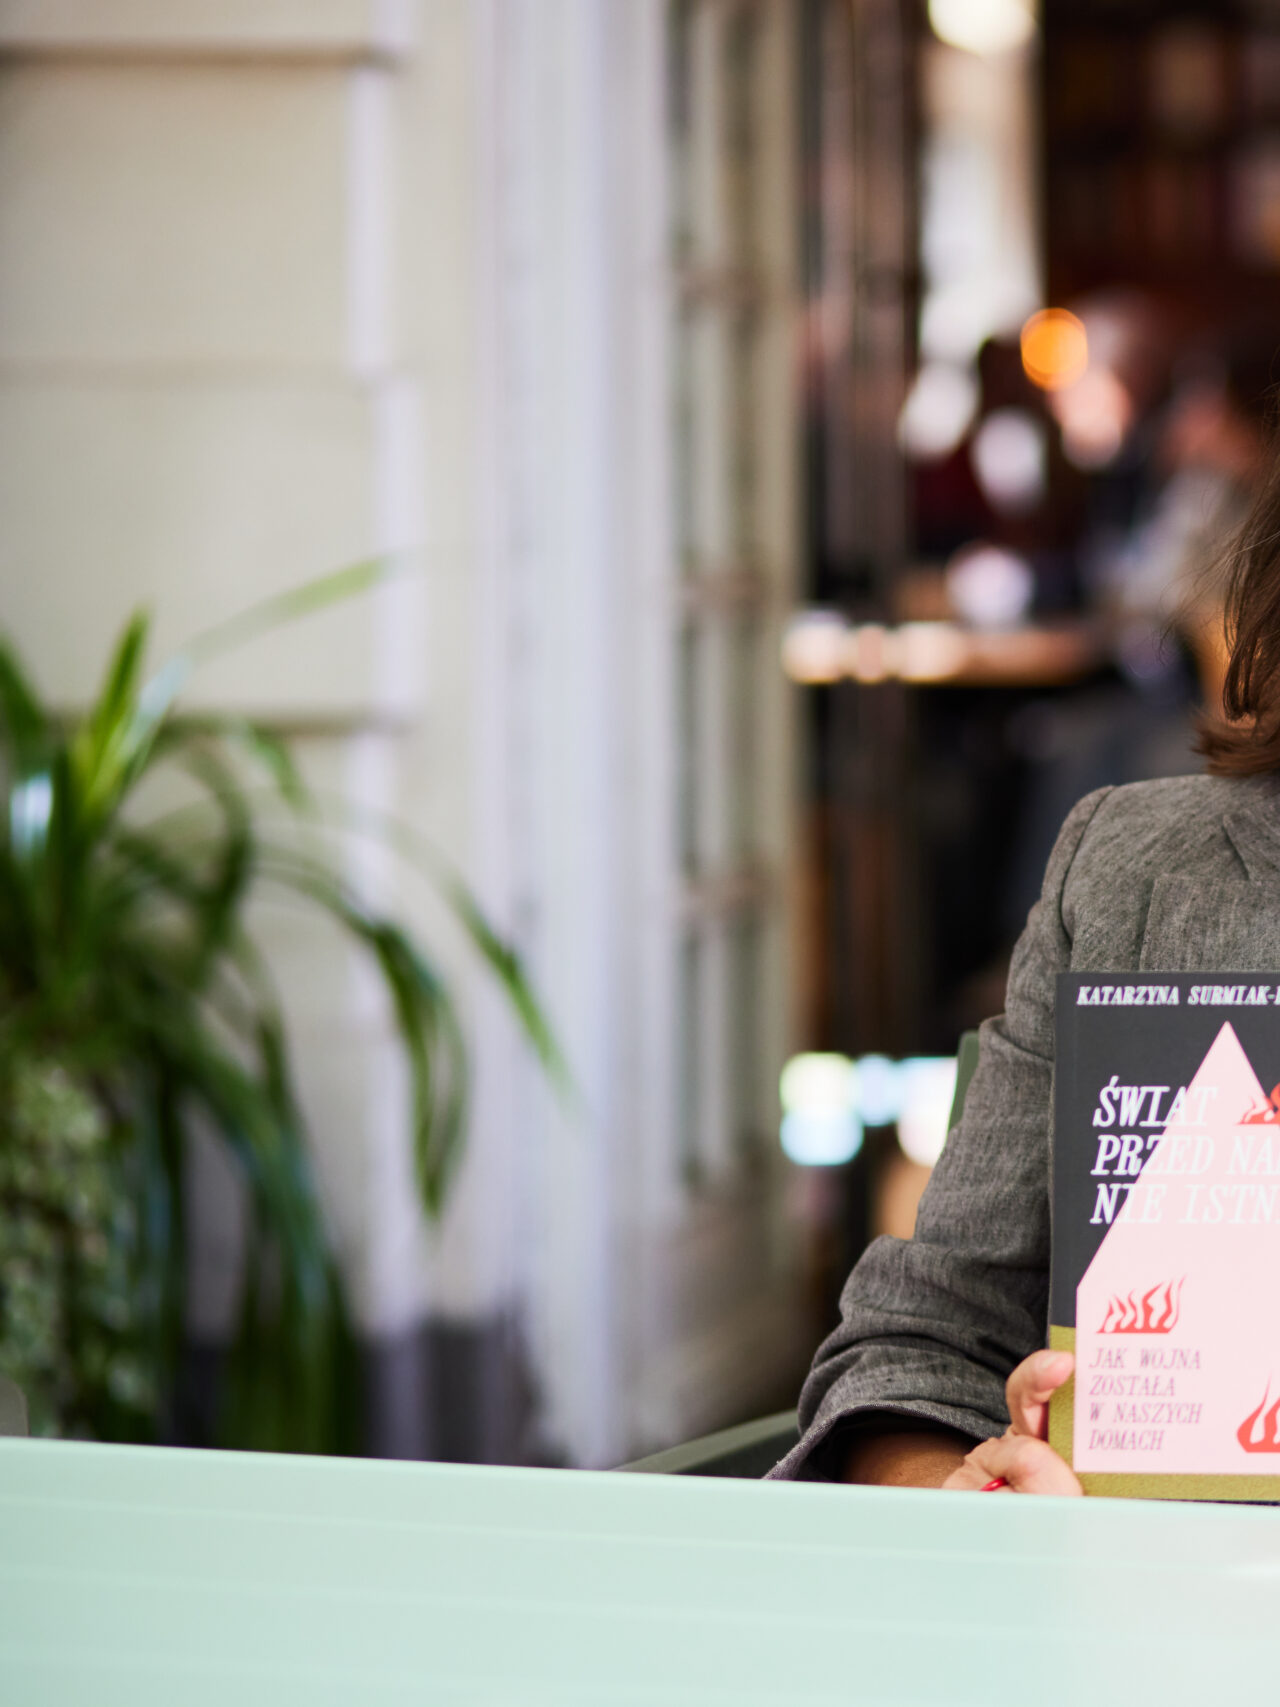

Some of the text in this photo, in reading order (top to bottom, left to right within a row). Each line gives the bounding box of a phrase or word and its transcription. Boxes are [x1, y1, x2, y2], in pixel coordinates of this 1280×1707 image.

[1076, 986, 1180, 1006] KATARZYNA
[1092, 1075, 1219, 1127] ŚWIAT
[1090, 1134, 1215, 1176] PRZED
[1090, 1183, 1168, 1225] NIE
[1088, 1347, 1202, 1370] JAK WOJNA
[1088, 1375, 1176, 1397] ZOSTAŁA
[1089, 1402, 1203, 1425] W NASZYCH
[1088, 1430, 1166, 1451] DOMACH
